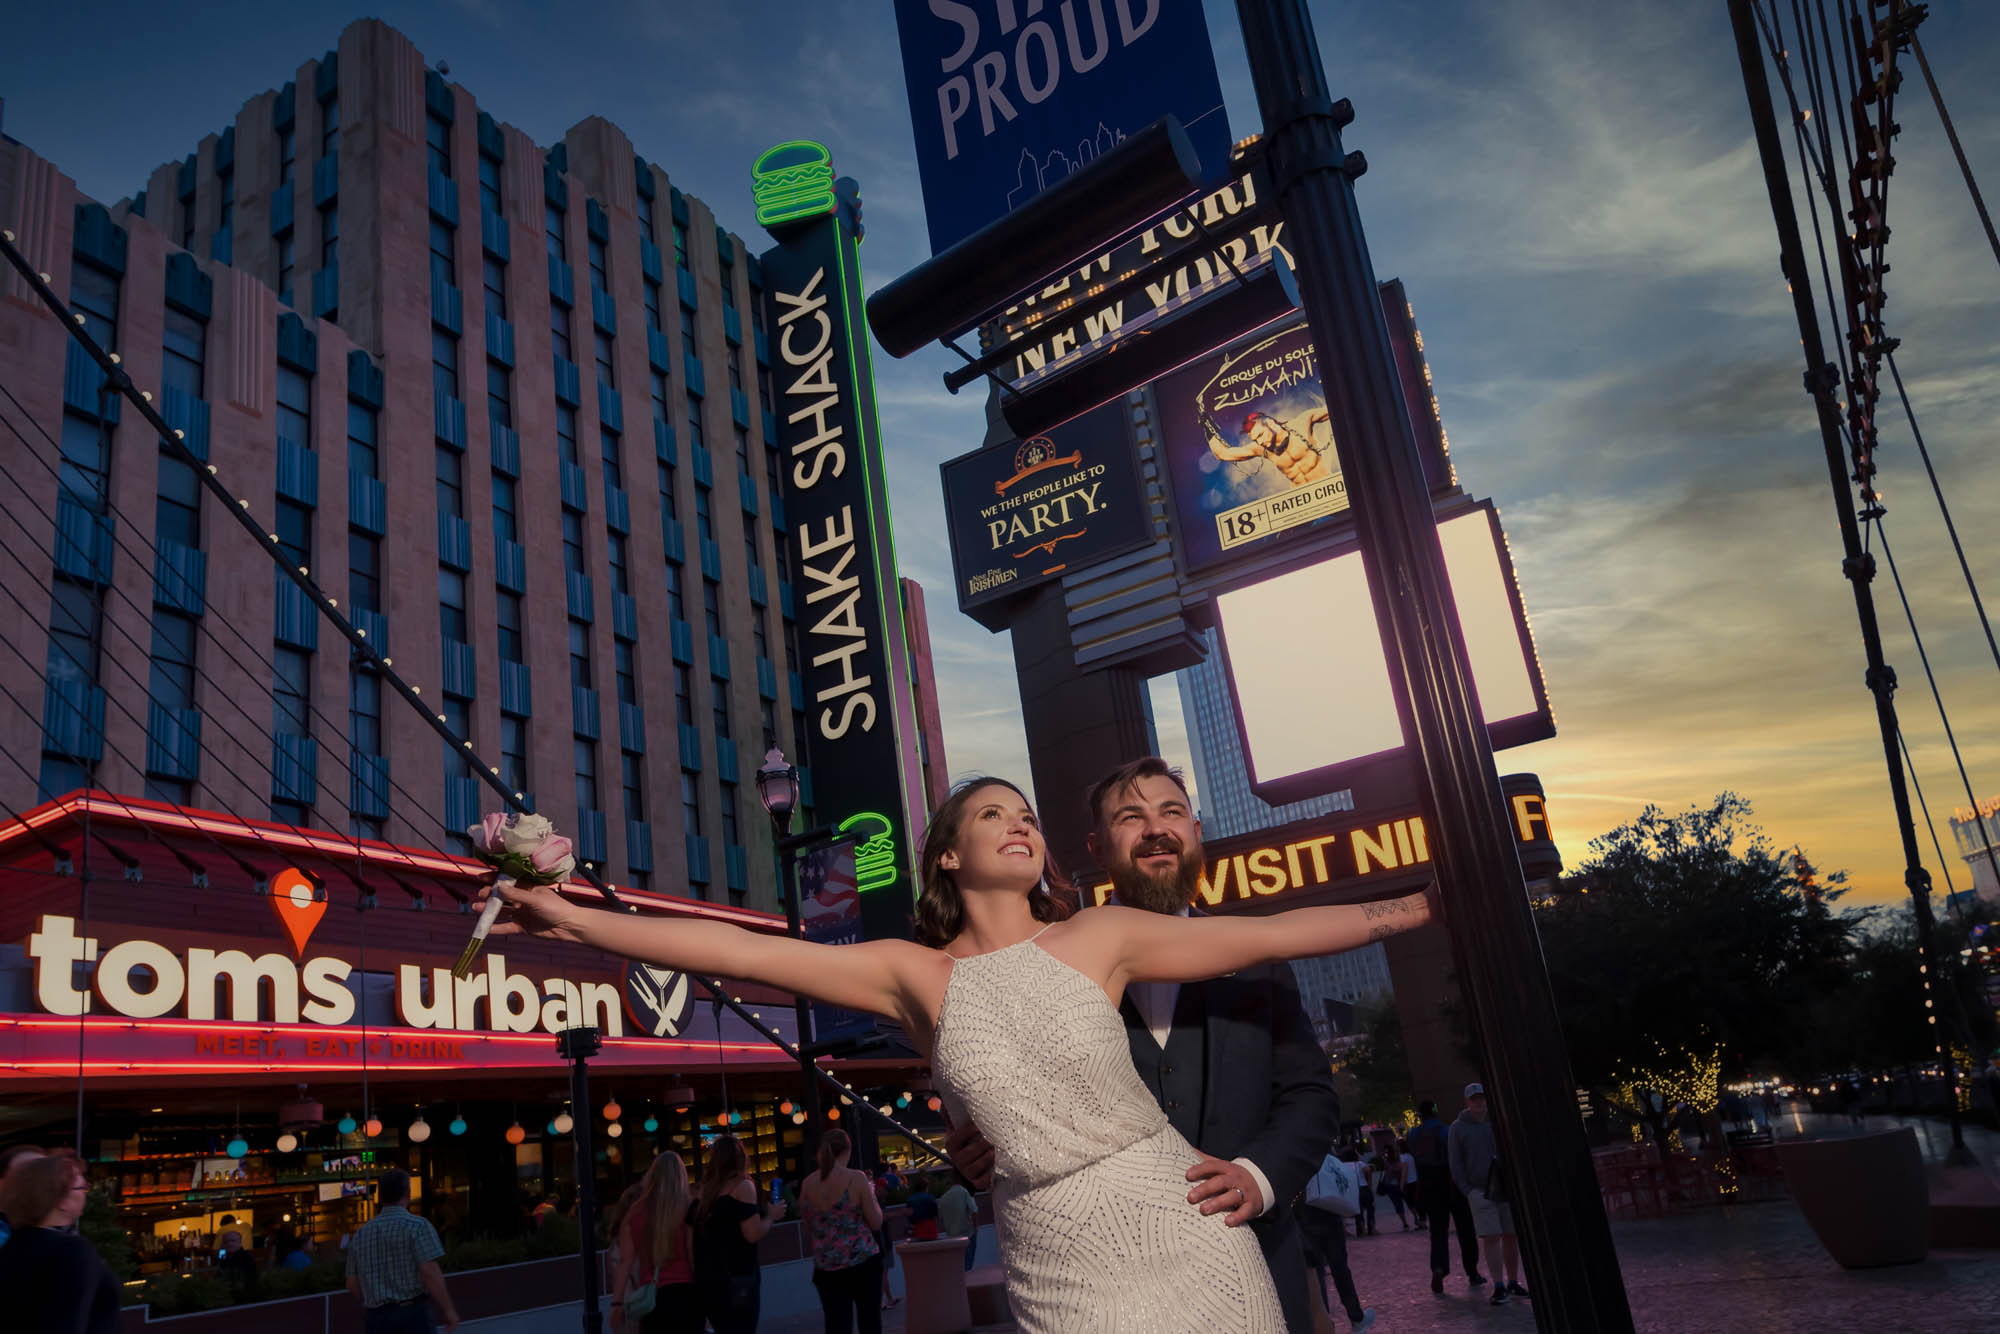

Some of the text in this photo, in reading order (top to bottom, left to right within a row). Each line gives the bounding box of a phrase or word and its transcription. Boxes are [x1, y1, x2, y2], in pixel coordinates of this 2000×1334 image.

[937, 0, 1160, 160] PROUD
[1219, 364, 1263, 389] CIRQUE
[1266, 357, 1283, 371] DU
[775, 266, 876, 741] SHAKE SHACK
[981, 464, 1105, 519] WE THE PEOPLE LIKE TO
[987, 482, 1107, 550] PARTY.
[1223, 509, 1267, 543] 18+
[1272, 491, 1311, 515] RATED
[1197, 834, 1336, 906] VISIT
[1511, 794, 1552, 842] F
[29, 914, 624, 1037] toms urban
[196, 1033, 287, 1060] MEET,
[306, 1036, 360, 1058] EAT
[391, 1039, 465, 1060] DRINK
